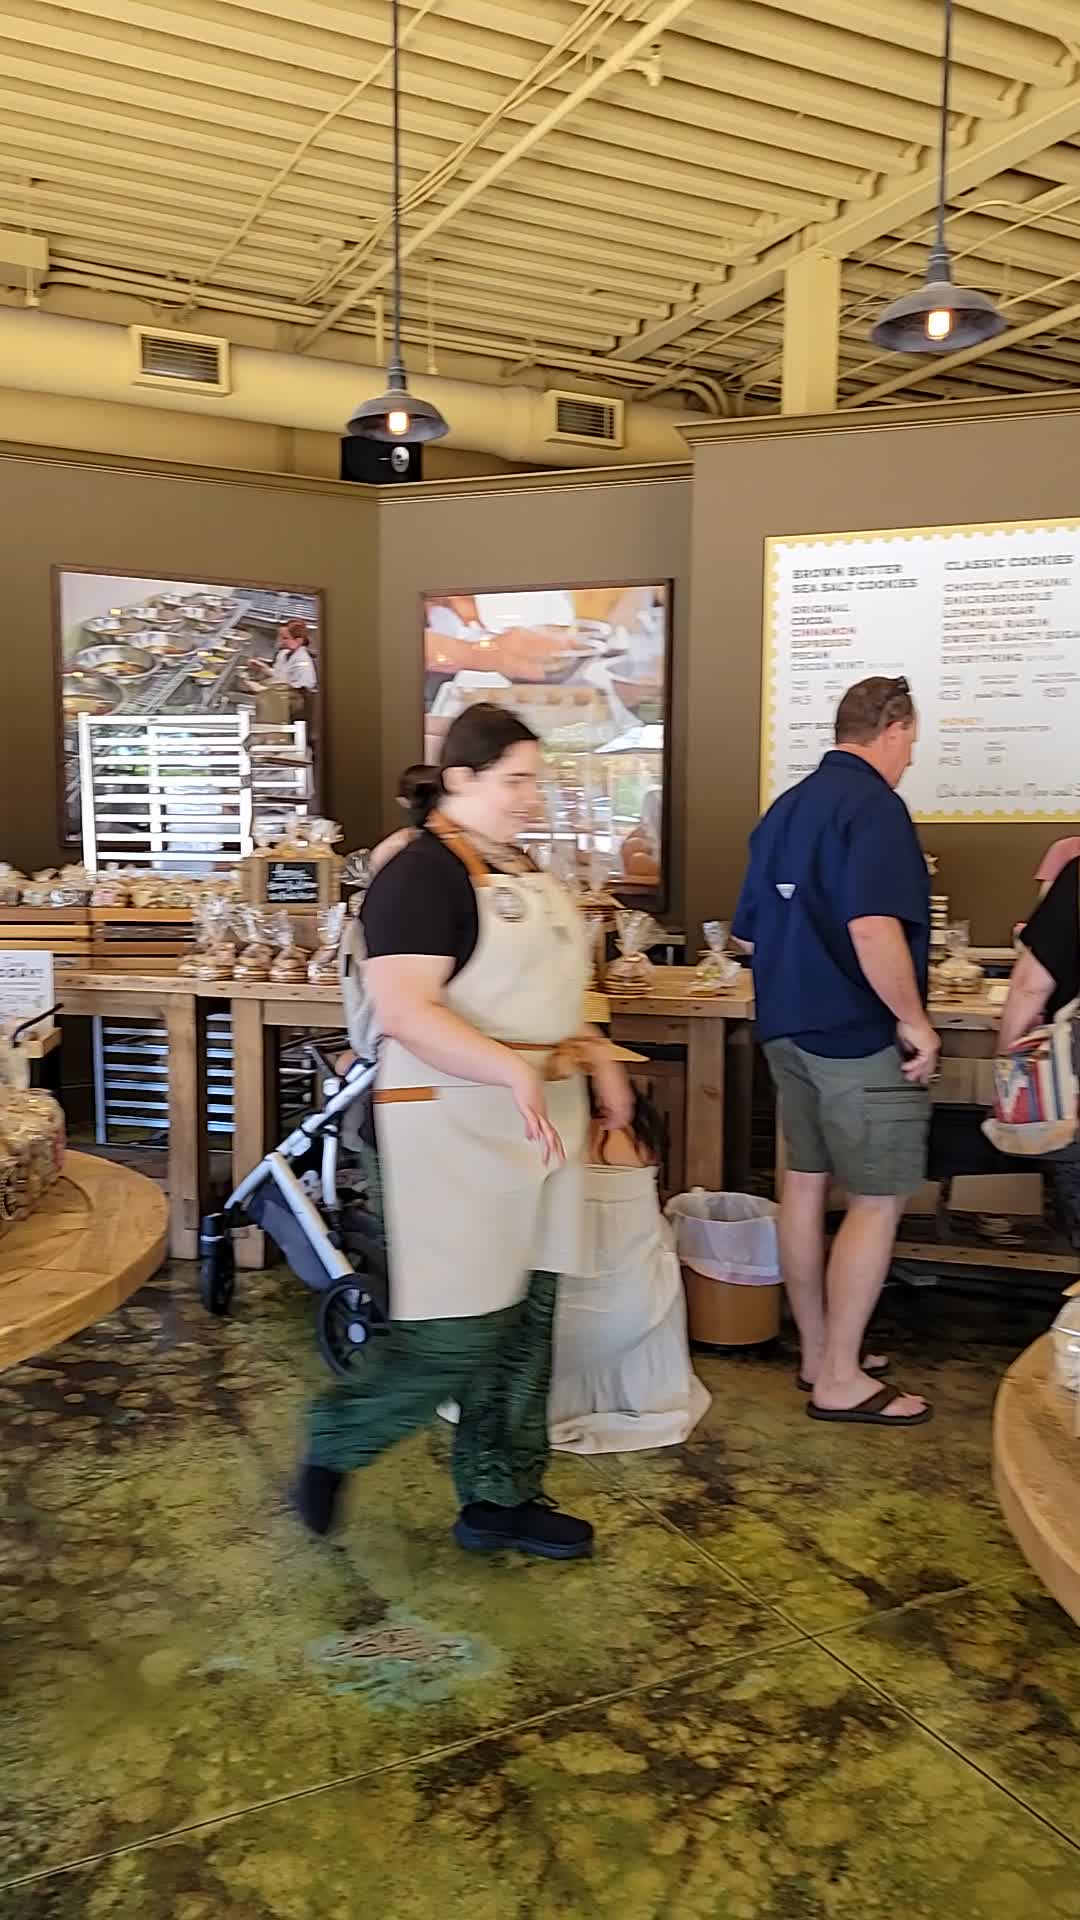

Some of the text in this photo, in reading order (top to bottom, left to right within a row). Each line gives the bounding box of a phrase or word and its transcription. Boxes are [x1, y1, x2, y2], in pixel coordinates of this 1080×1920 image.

[944, 554, 1074, 570] CLASSIC COOKIES
[792, 564, 903, 579] BROWN BUTTER
[792, 578, 919, 594] SEA SALT COOKIES
[944, 580, 1021, 592] CHOCOLATE
[943, 591, 1053, 605] SNICKERDOODLE
[791, 603, 851, 614] ORIGINAL
[943, 605, 1035, 619] LEMON SUGAR
[943, 620, 1001, 631] OATMEAL
[943, 634, 985, 644] SWEET
